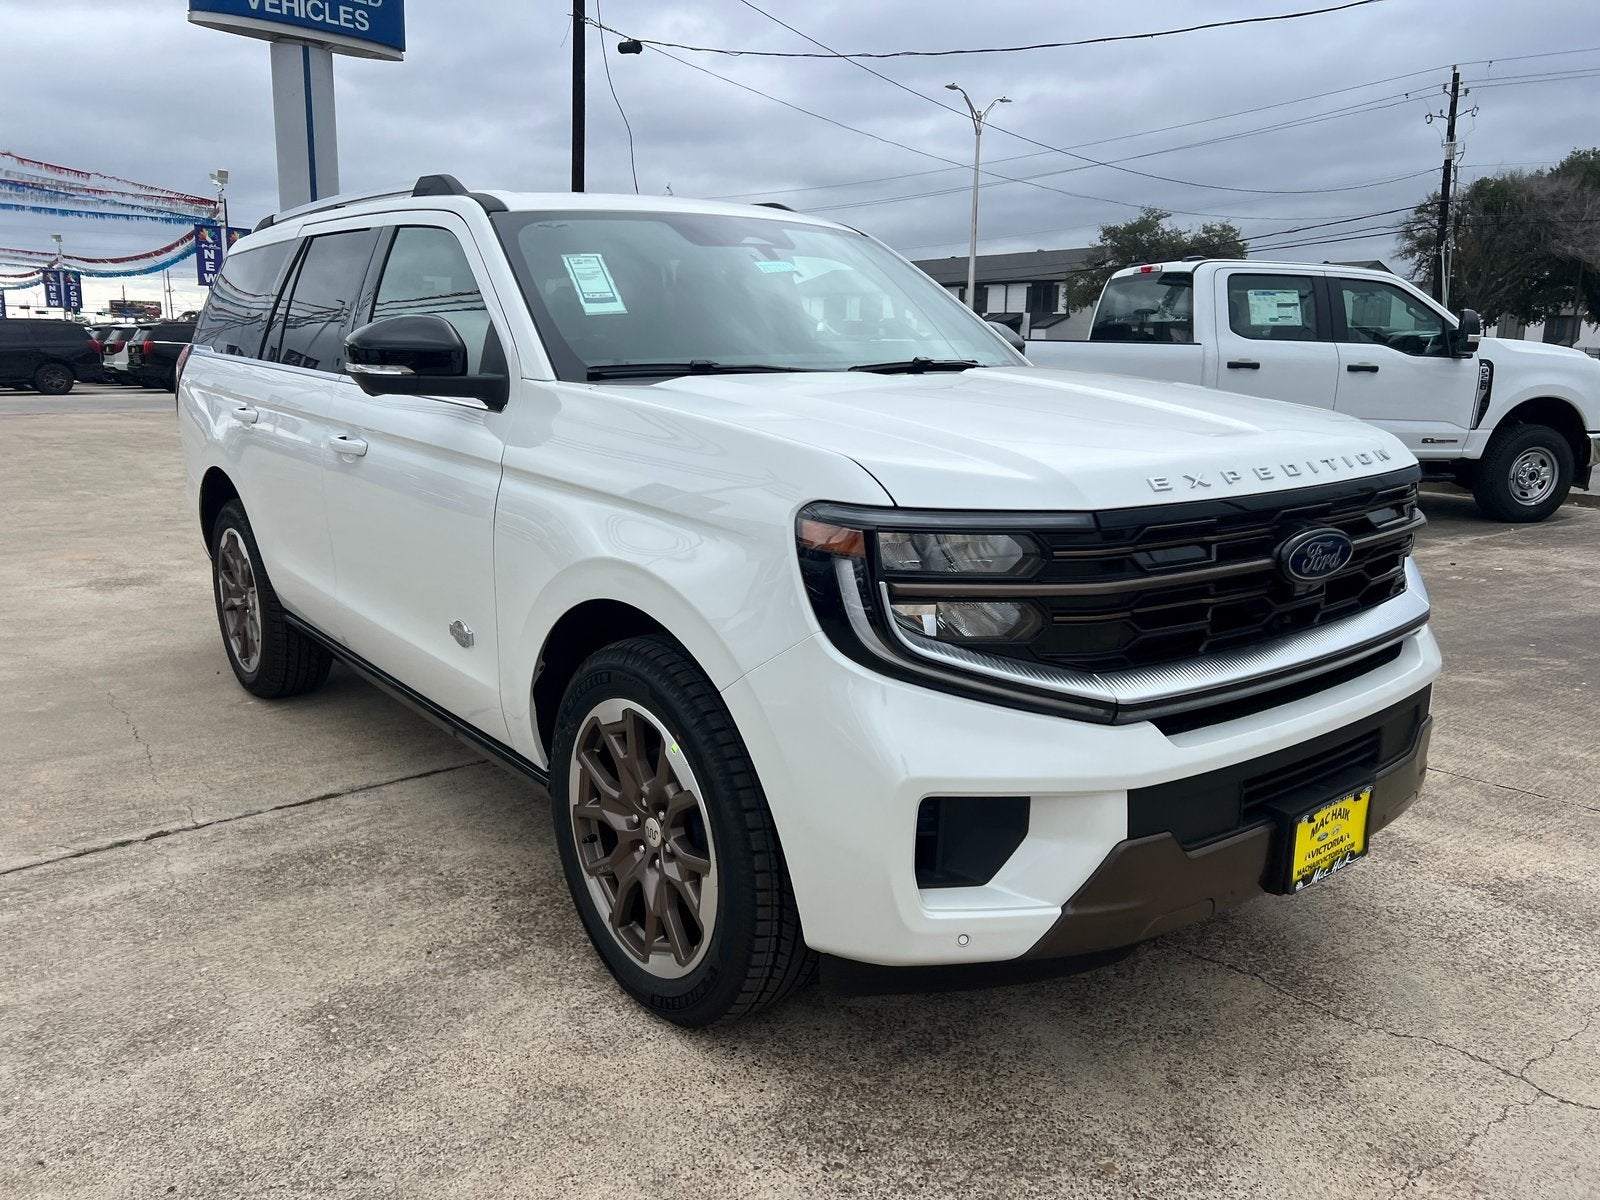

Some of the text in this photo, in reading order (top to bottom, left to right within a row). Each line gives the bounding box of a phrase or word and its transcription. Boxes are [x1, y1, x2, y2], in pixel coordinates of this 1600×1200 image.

[203, 249, 217, 283] NEW
[48, 285, 59, 306] NEW
[69, 285, 79, 307] FORD
[1146, 449, 1391, 492] EXPEDITION
[1302, 540, 1342, 574] Ford
[1310, 812, 1331, 840] MAC
[1331, 807, 1350, 821] HAIK
[1311, 834, 1344, 858] VICTORIA
